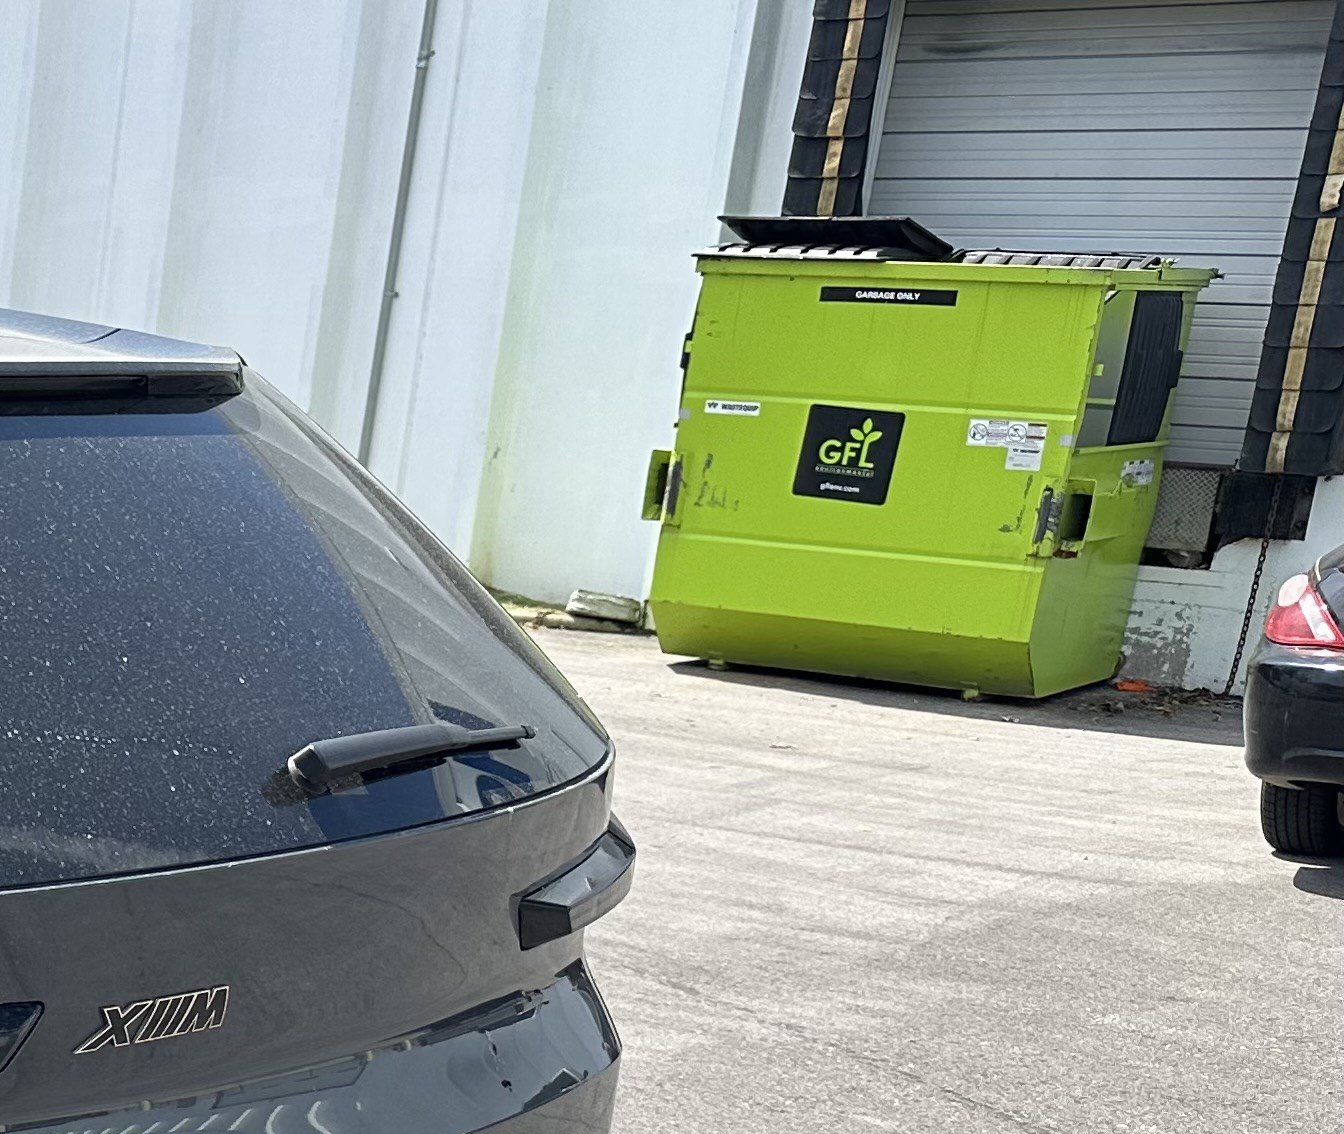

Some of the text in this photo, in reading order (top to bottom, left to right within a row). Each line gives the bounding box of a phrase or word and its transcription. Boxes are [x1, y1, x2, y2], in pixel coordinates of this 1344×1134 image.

[855, 291, 920, 300] GARBAGE ONLY
[819, 429, 881, 468] GFL
